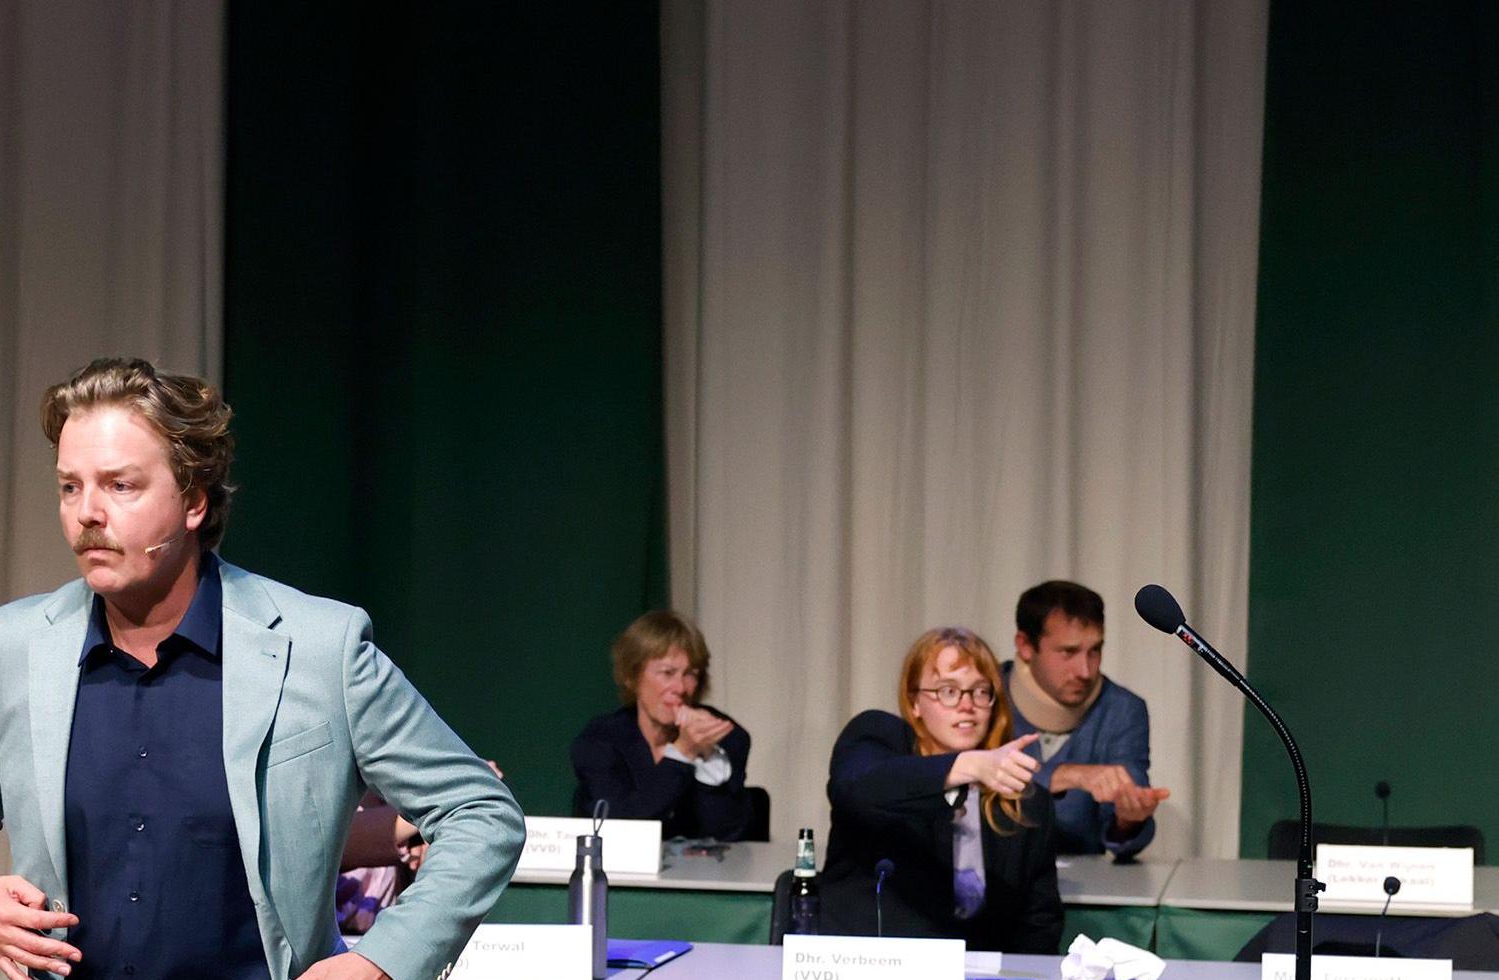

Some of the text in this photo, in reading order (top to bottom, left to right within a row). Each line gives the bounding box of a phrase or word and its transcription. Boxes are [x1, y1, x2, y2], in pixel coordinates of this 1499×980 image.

[473, 941, 525, 952] Terwal
[795, 952, 902, 967] Dhr. Verbeem
